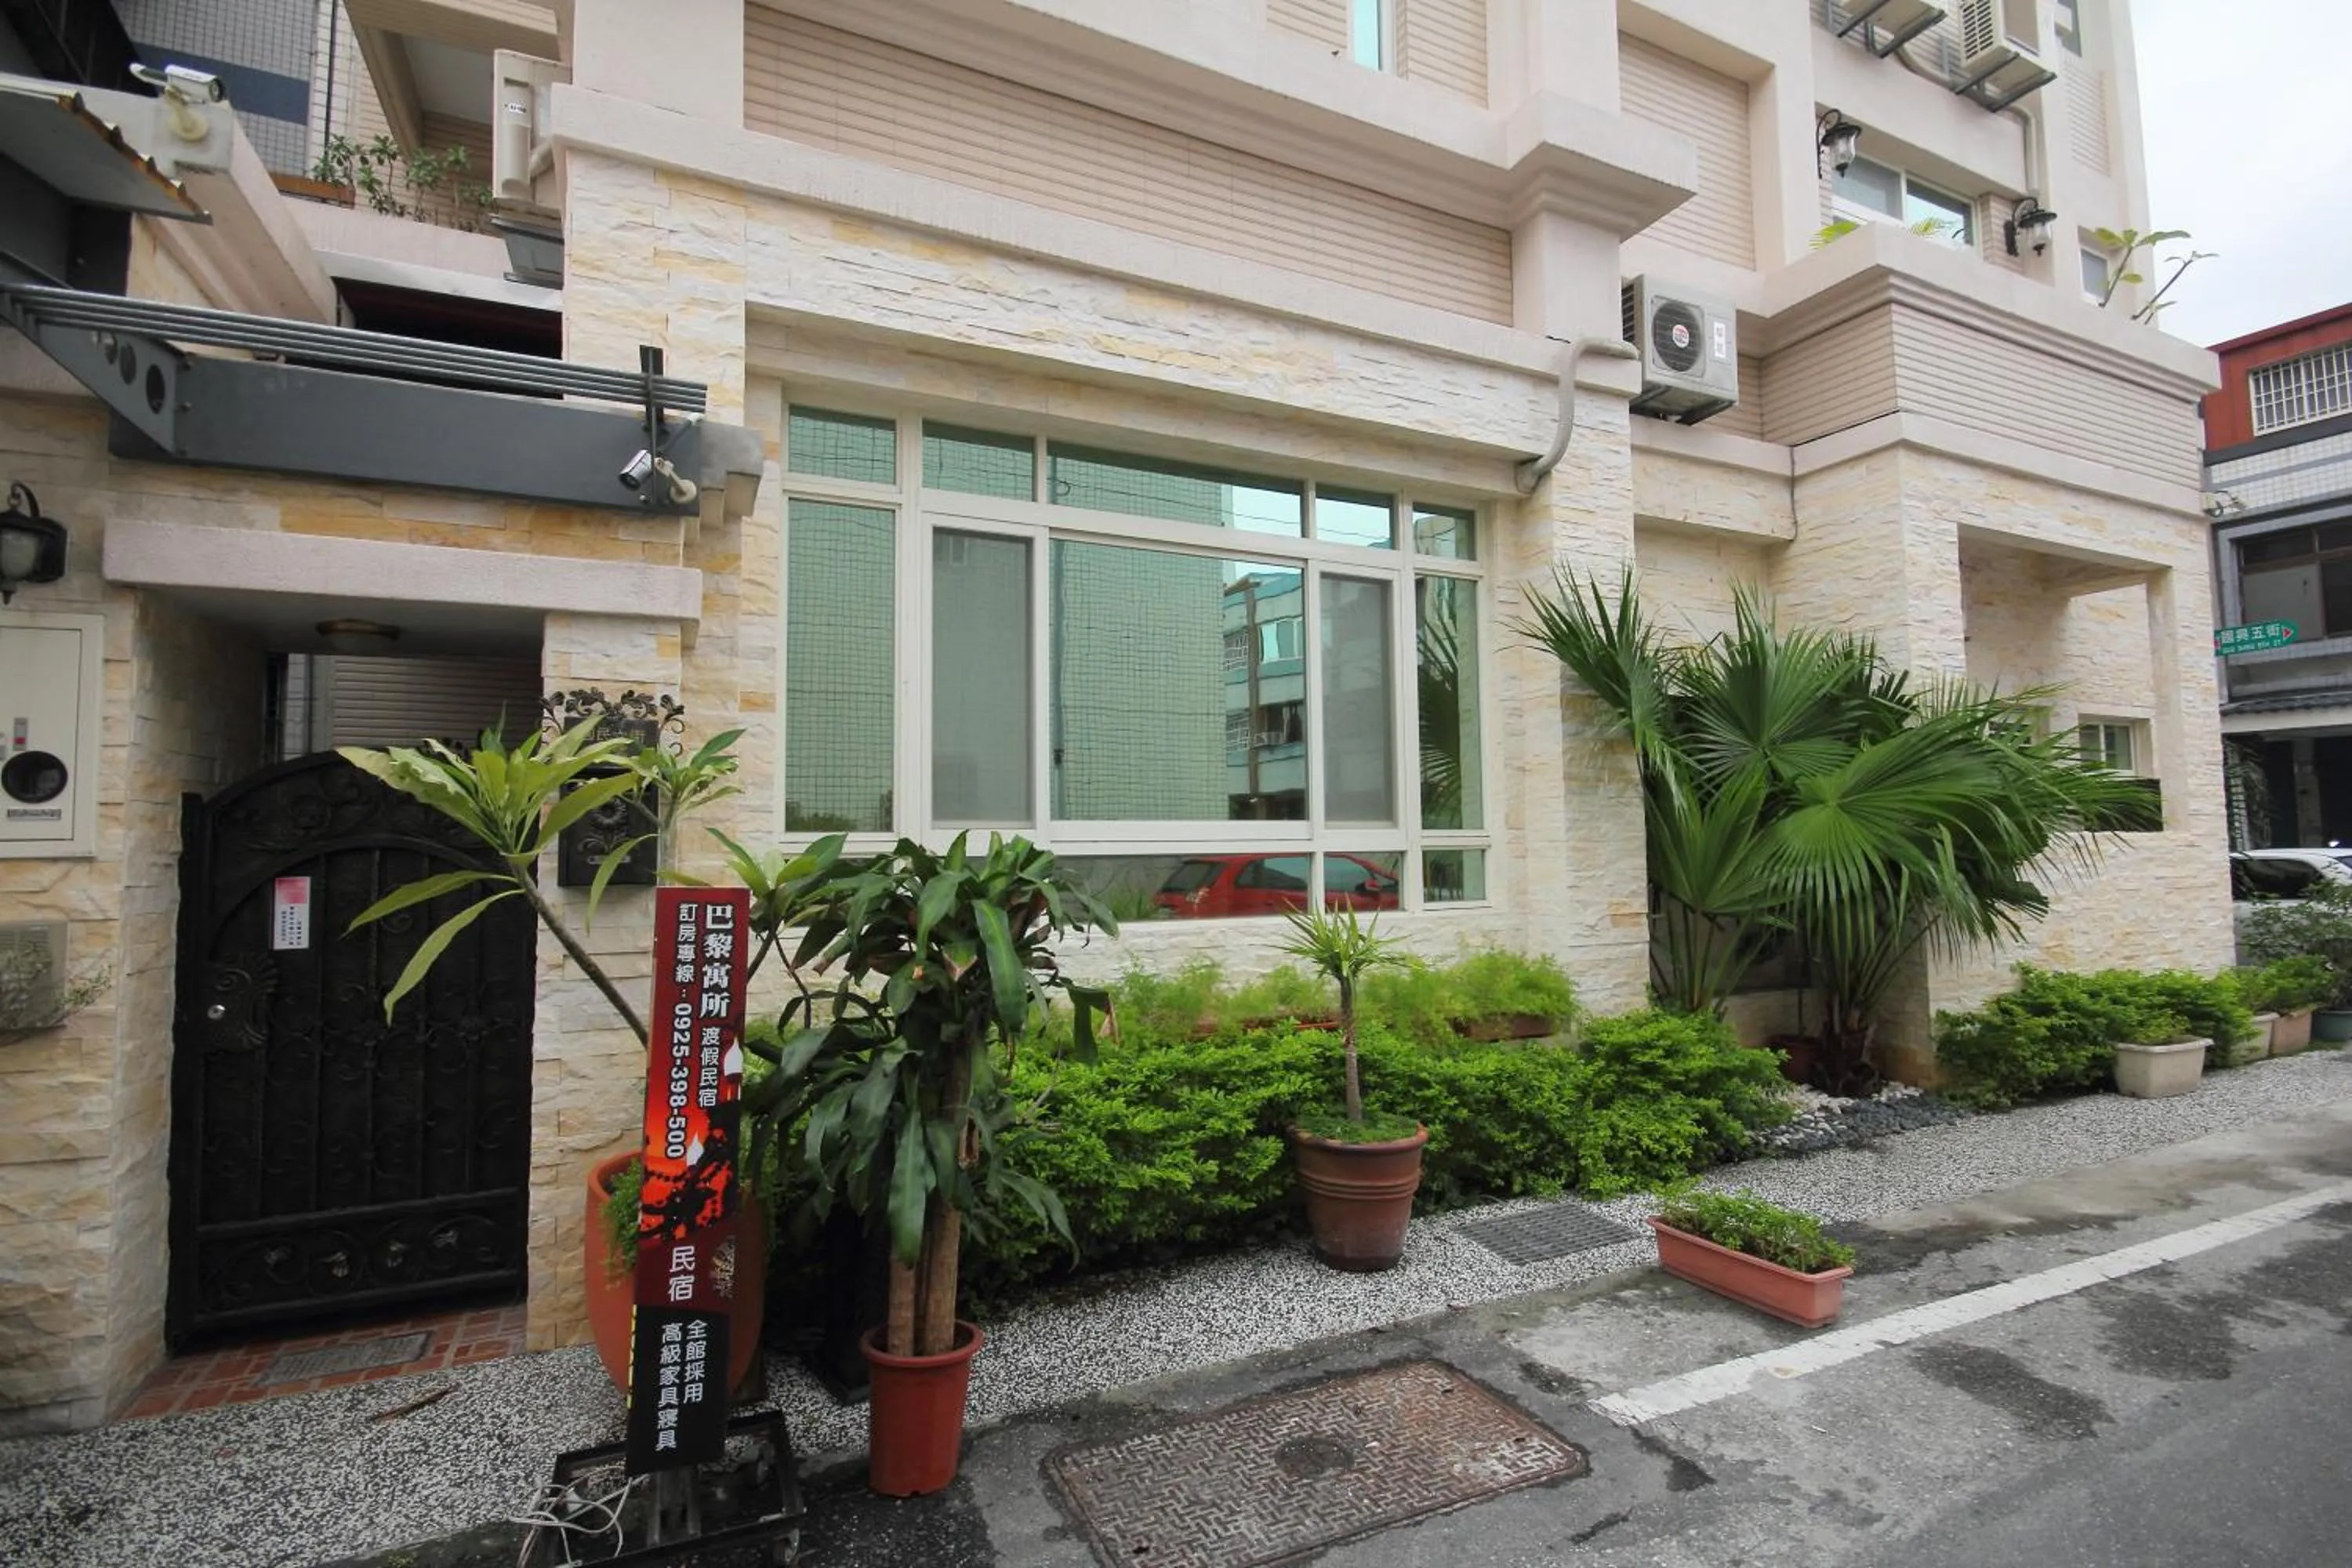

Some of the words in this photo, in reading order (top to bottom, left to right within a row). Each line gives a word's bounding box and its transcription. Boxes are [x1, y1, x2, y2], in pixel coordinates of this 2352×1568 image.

[699, 904, 734, 1018] 巴黎寓所
[666, 1003, 692, 1159] 0925-398-500
[699, 1026, 720, 1107] 渡假民宿
[668, 1245, 695, 1302] 民宿
[655, 1323, 683, 1451] 高級家具寢具
[683, 1319, 708, 1404] 全館採用
